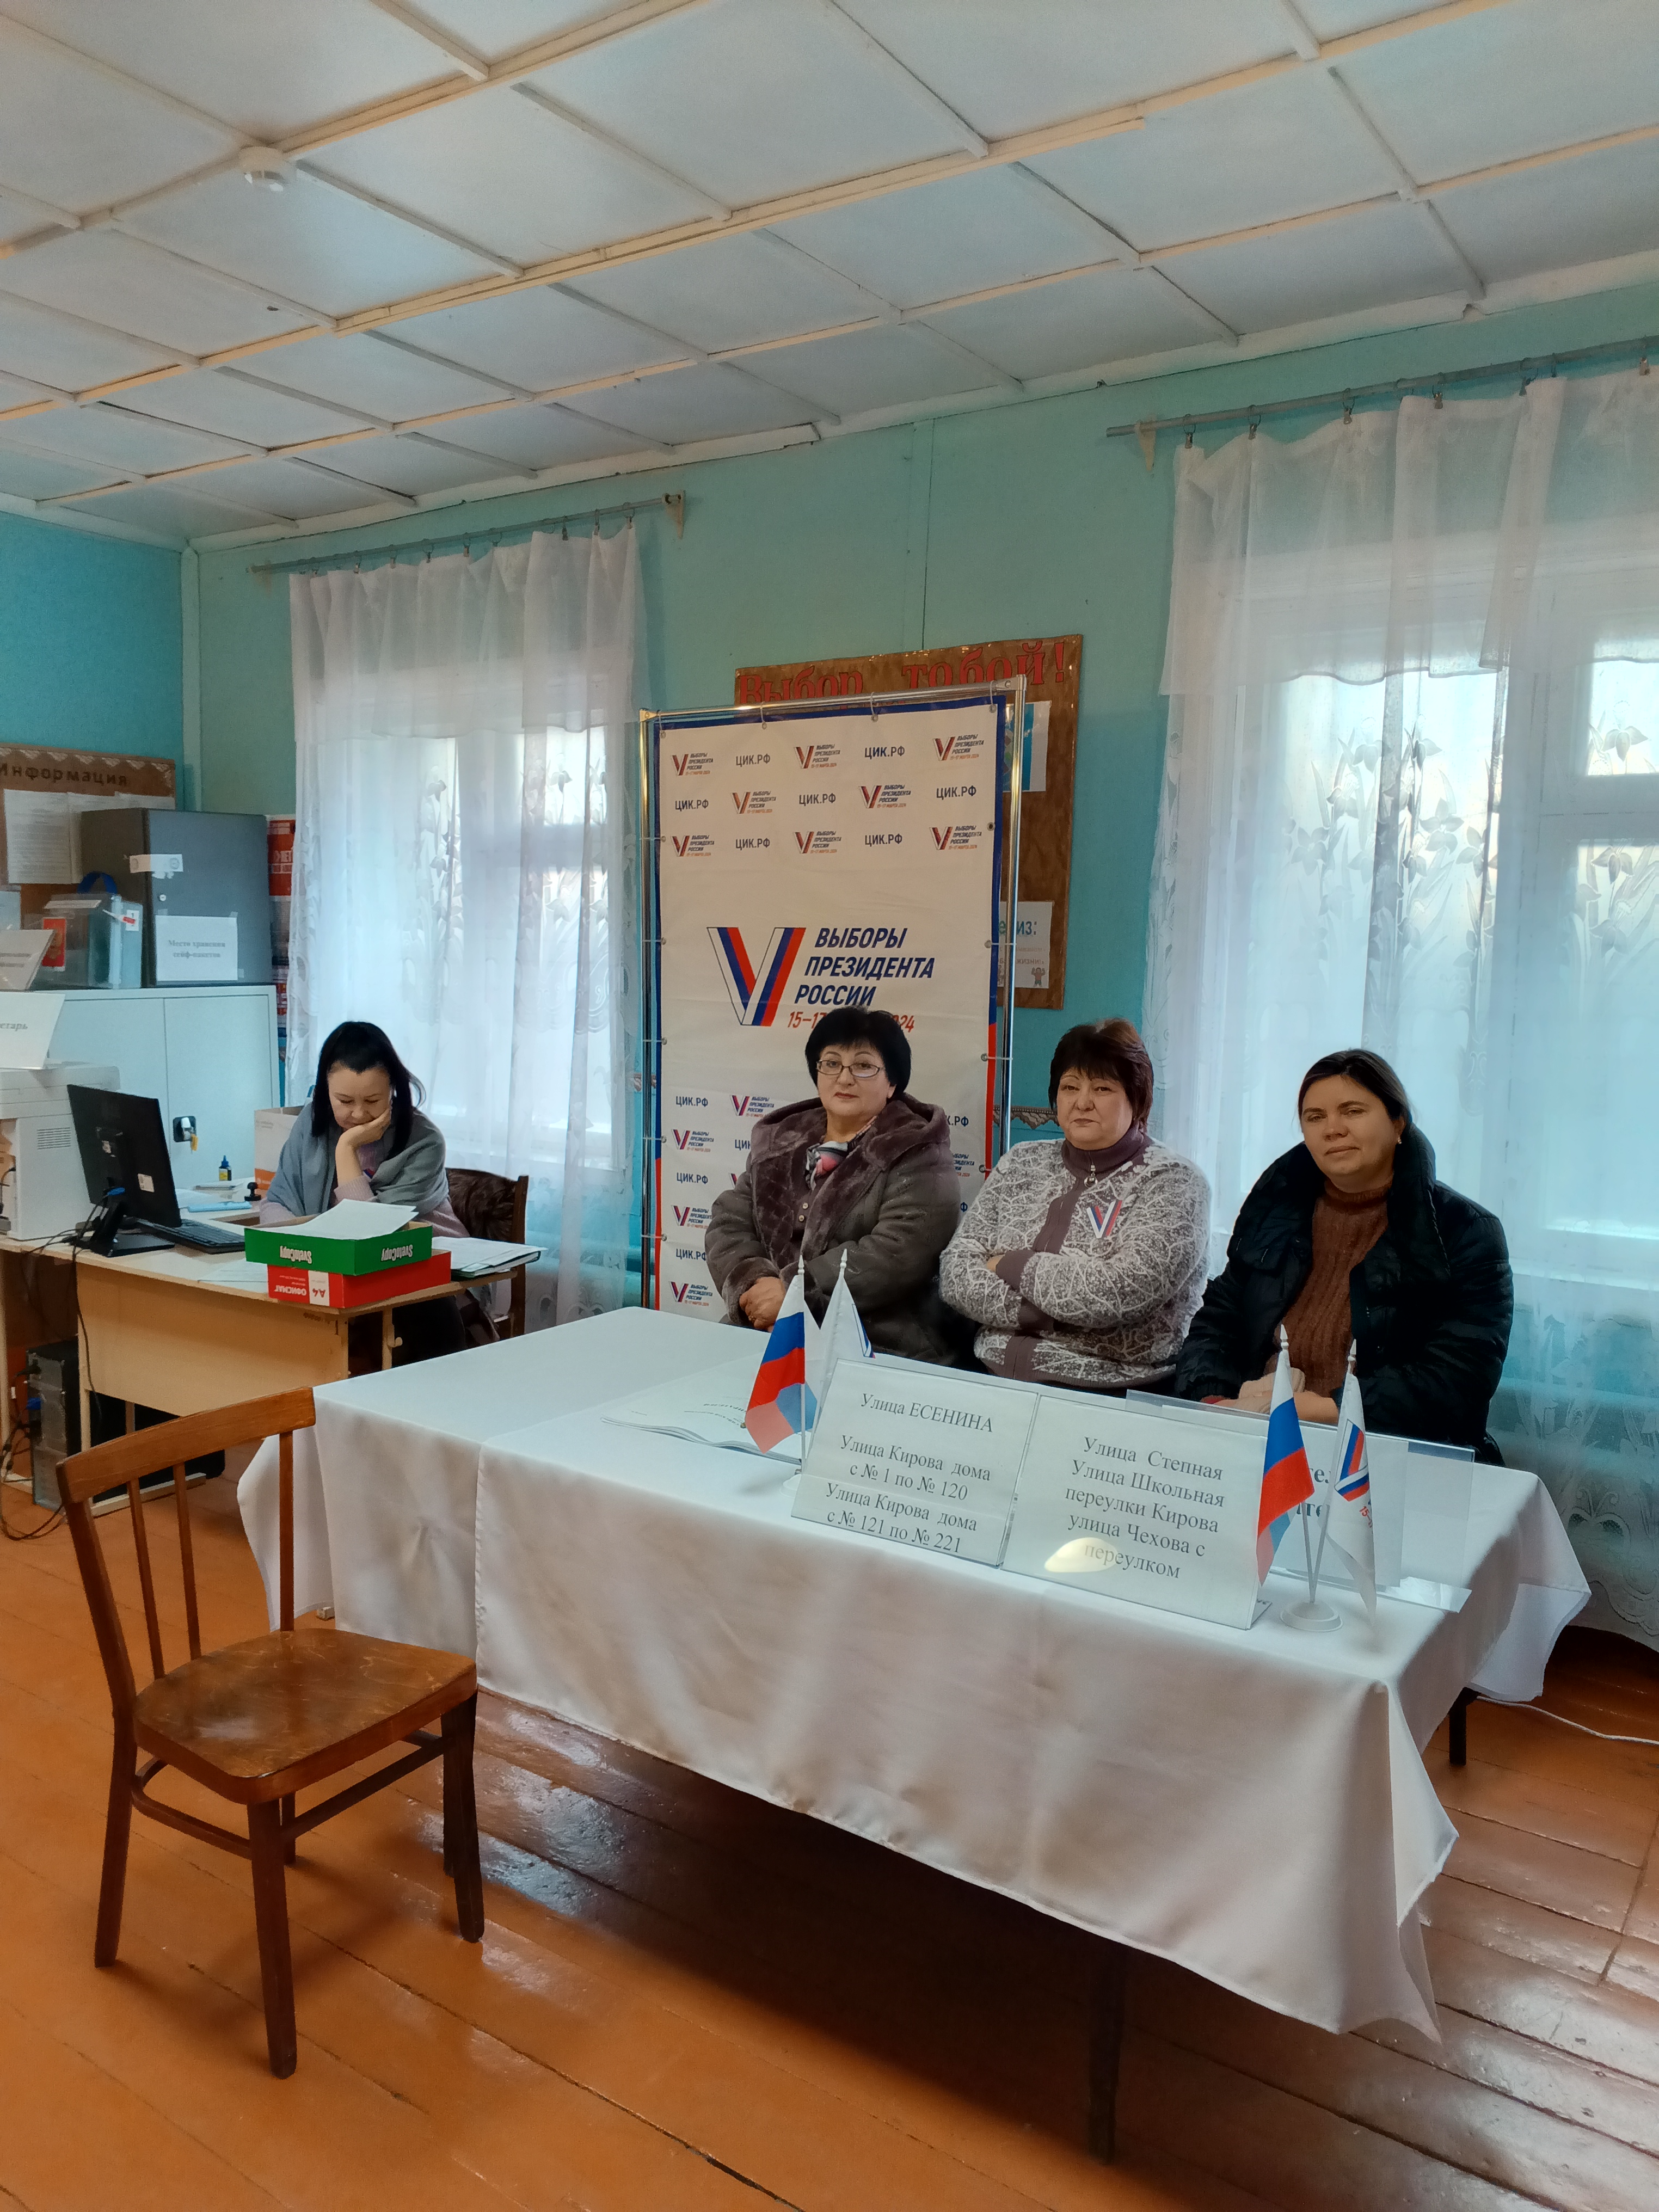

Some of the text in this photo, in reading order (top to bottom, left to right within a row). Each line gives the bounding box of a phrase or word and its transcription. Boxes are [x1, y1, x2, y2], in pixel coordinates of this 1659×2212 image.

[735, 753, 771, 767] ЦИК.РФ
[864, 746, 905, 759] ЦИК.РФ
[799, 792, 836, 806] ЦИК.РФ
[936, 785, 976, 800] ЦИК.РФ
[675, 799, 709, 812] ЦИК.РФ
[735, 838, 770, 850] ЦИК.РФ
[865, 833, 902, 847] ЦИК.РФ
[814, 927, 908, 948] ВЫБОРЫ
[804, 956, 935, 981] ПРЕЗИДЕНТА
[794, 985, 876, 1006] РОССИИ
[675, 1096, 708, 1107] ЦИК.РФ
[677, 1172, 708, 1184] ЦИК.РФ
[280, 1245, 312, 1264] SvetoCopy
[381, 1244, 413, 1262] SvetoCopy
[861, 1393, 993, 1433] Улица ЕСЕНИНА
[841, 1435, 991, 1481] Улица Кирова дома
[1084, 1436, 1224, 1480] Улица Степная
[850, 1463, 968, 1501] с № 1 по № 120
[1072, 1459, 1225, 1507] Улица Школьная
[826, 1483, 978, 1531] Улица Кирова дома
[1065, 1488, 1219, 1533] переулки Кирова
[827, 1510, 962, 1553] с № 121 по № 221
[1068, 1515, 1206, 1557] улица Чехова с
[1084, 1545, 1181, 1578] переулком
